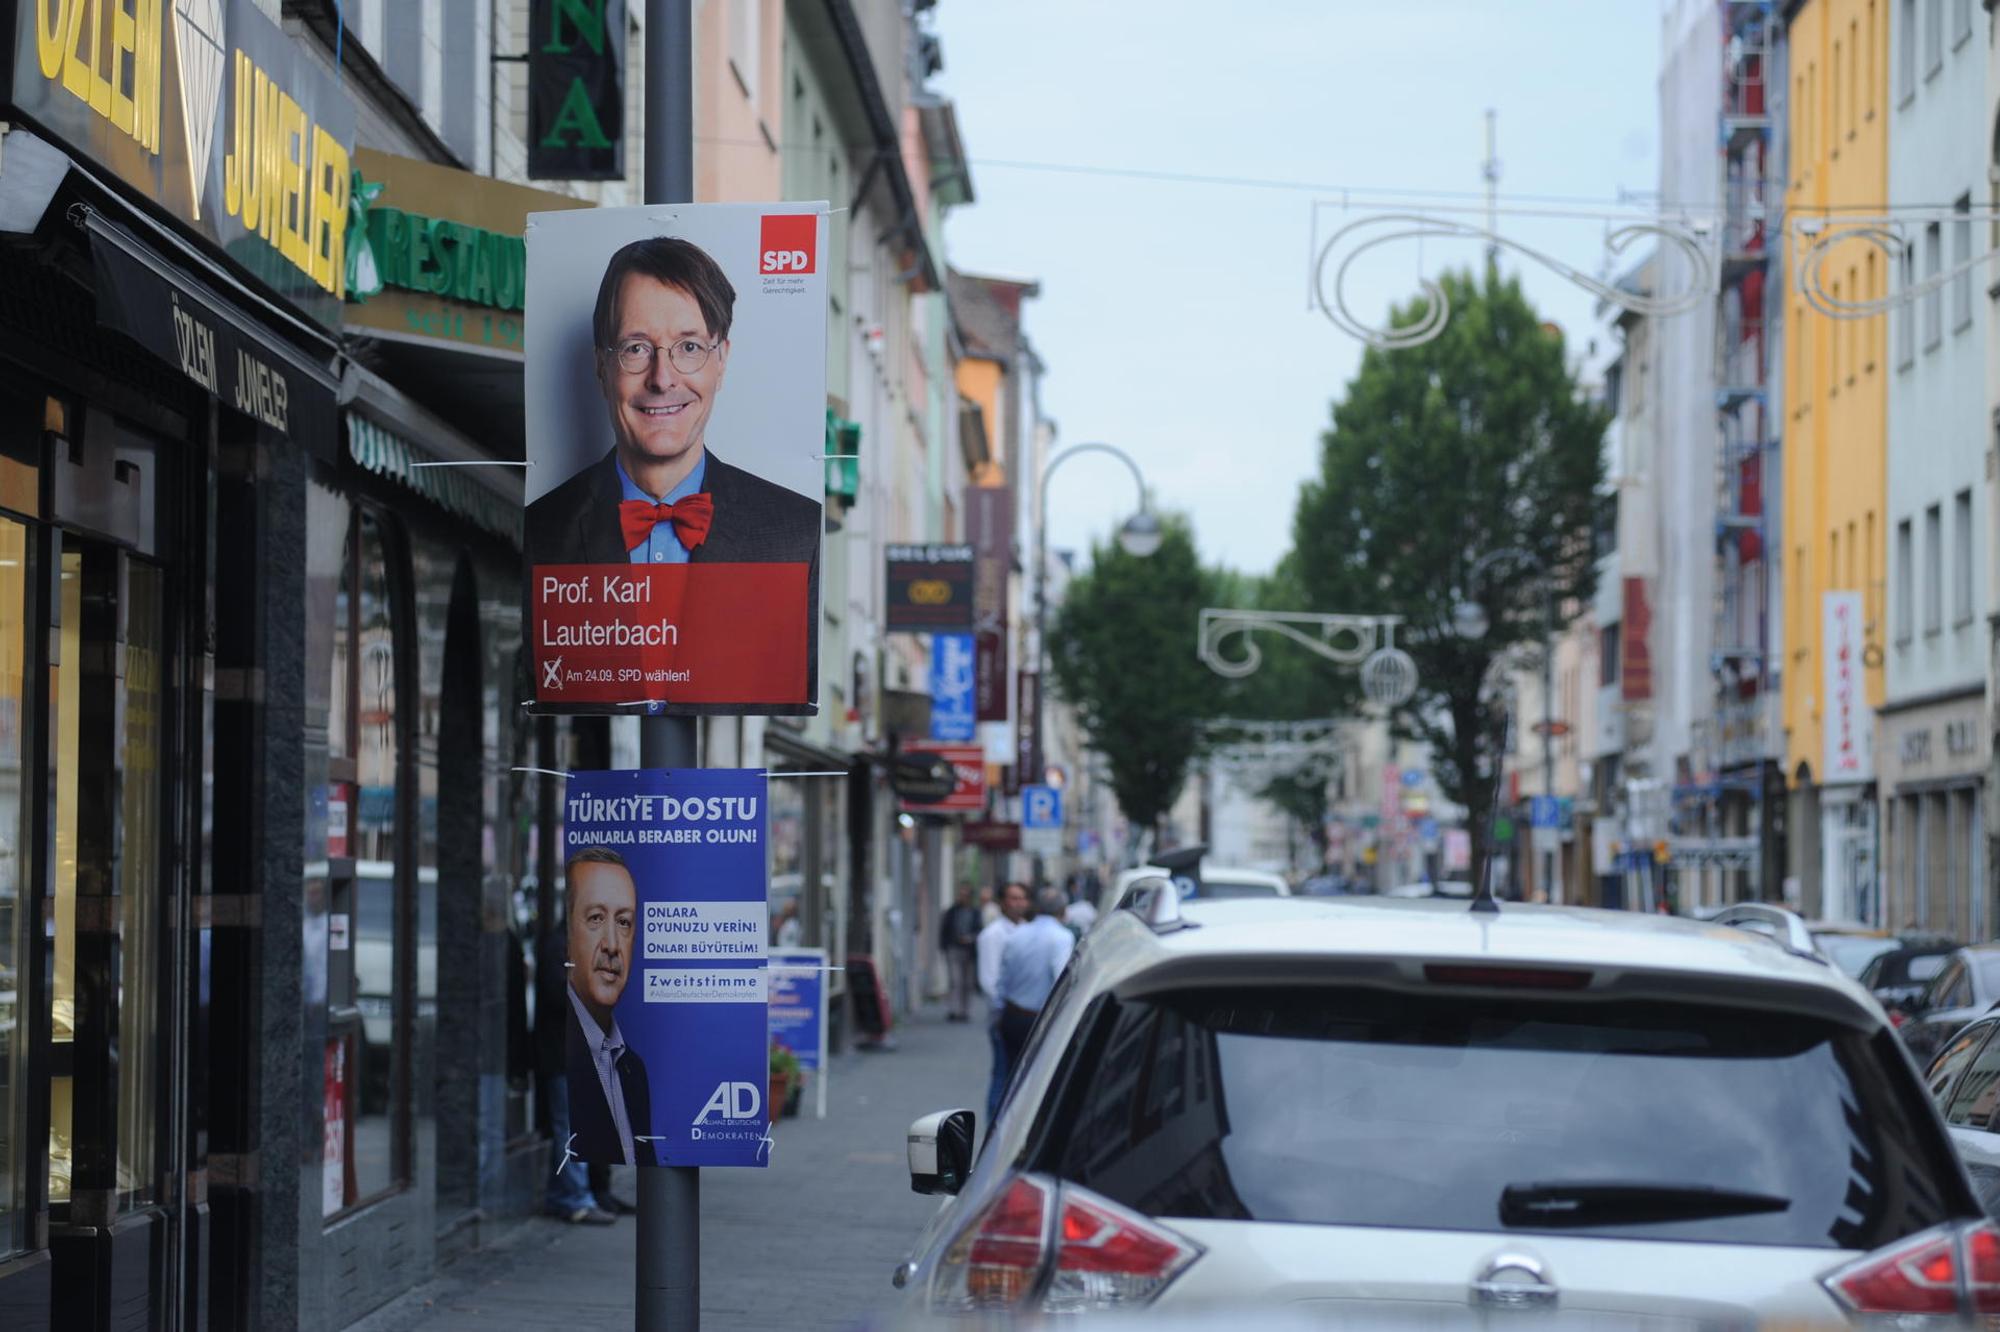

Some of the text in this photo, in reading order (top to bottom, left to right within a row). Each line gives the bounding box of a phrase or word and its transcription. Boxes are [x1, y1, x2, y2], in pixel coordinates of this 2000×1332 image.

[225, 47, 349, 300] JUWELIER
[383, 207, 525, 309] RESTAU
[762, 250, 807, 271] SPD
[482, 314, 525, 347] 19
[171, 290, 288, 432] ÖZLEM JUWELIER
[542, 575, 651, 604] Prof. Karl
[542, 618, 678, 646] Lauterbach
[566, 669, 690, 682] Am 24.09. SPD wählen!
[662, 797, 757, 821] DOSTU
[568, 829, 757, 845] OLANLARLA BERABER OLUN!
[647, 907, 698, 918] ONLARA
[647, 919, 757, 933] OYUNUZU VERİN!
[650, 975, 757, 987] Zweitstimme
[692, 1081, 761, 1126] AD
